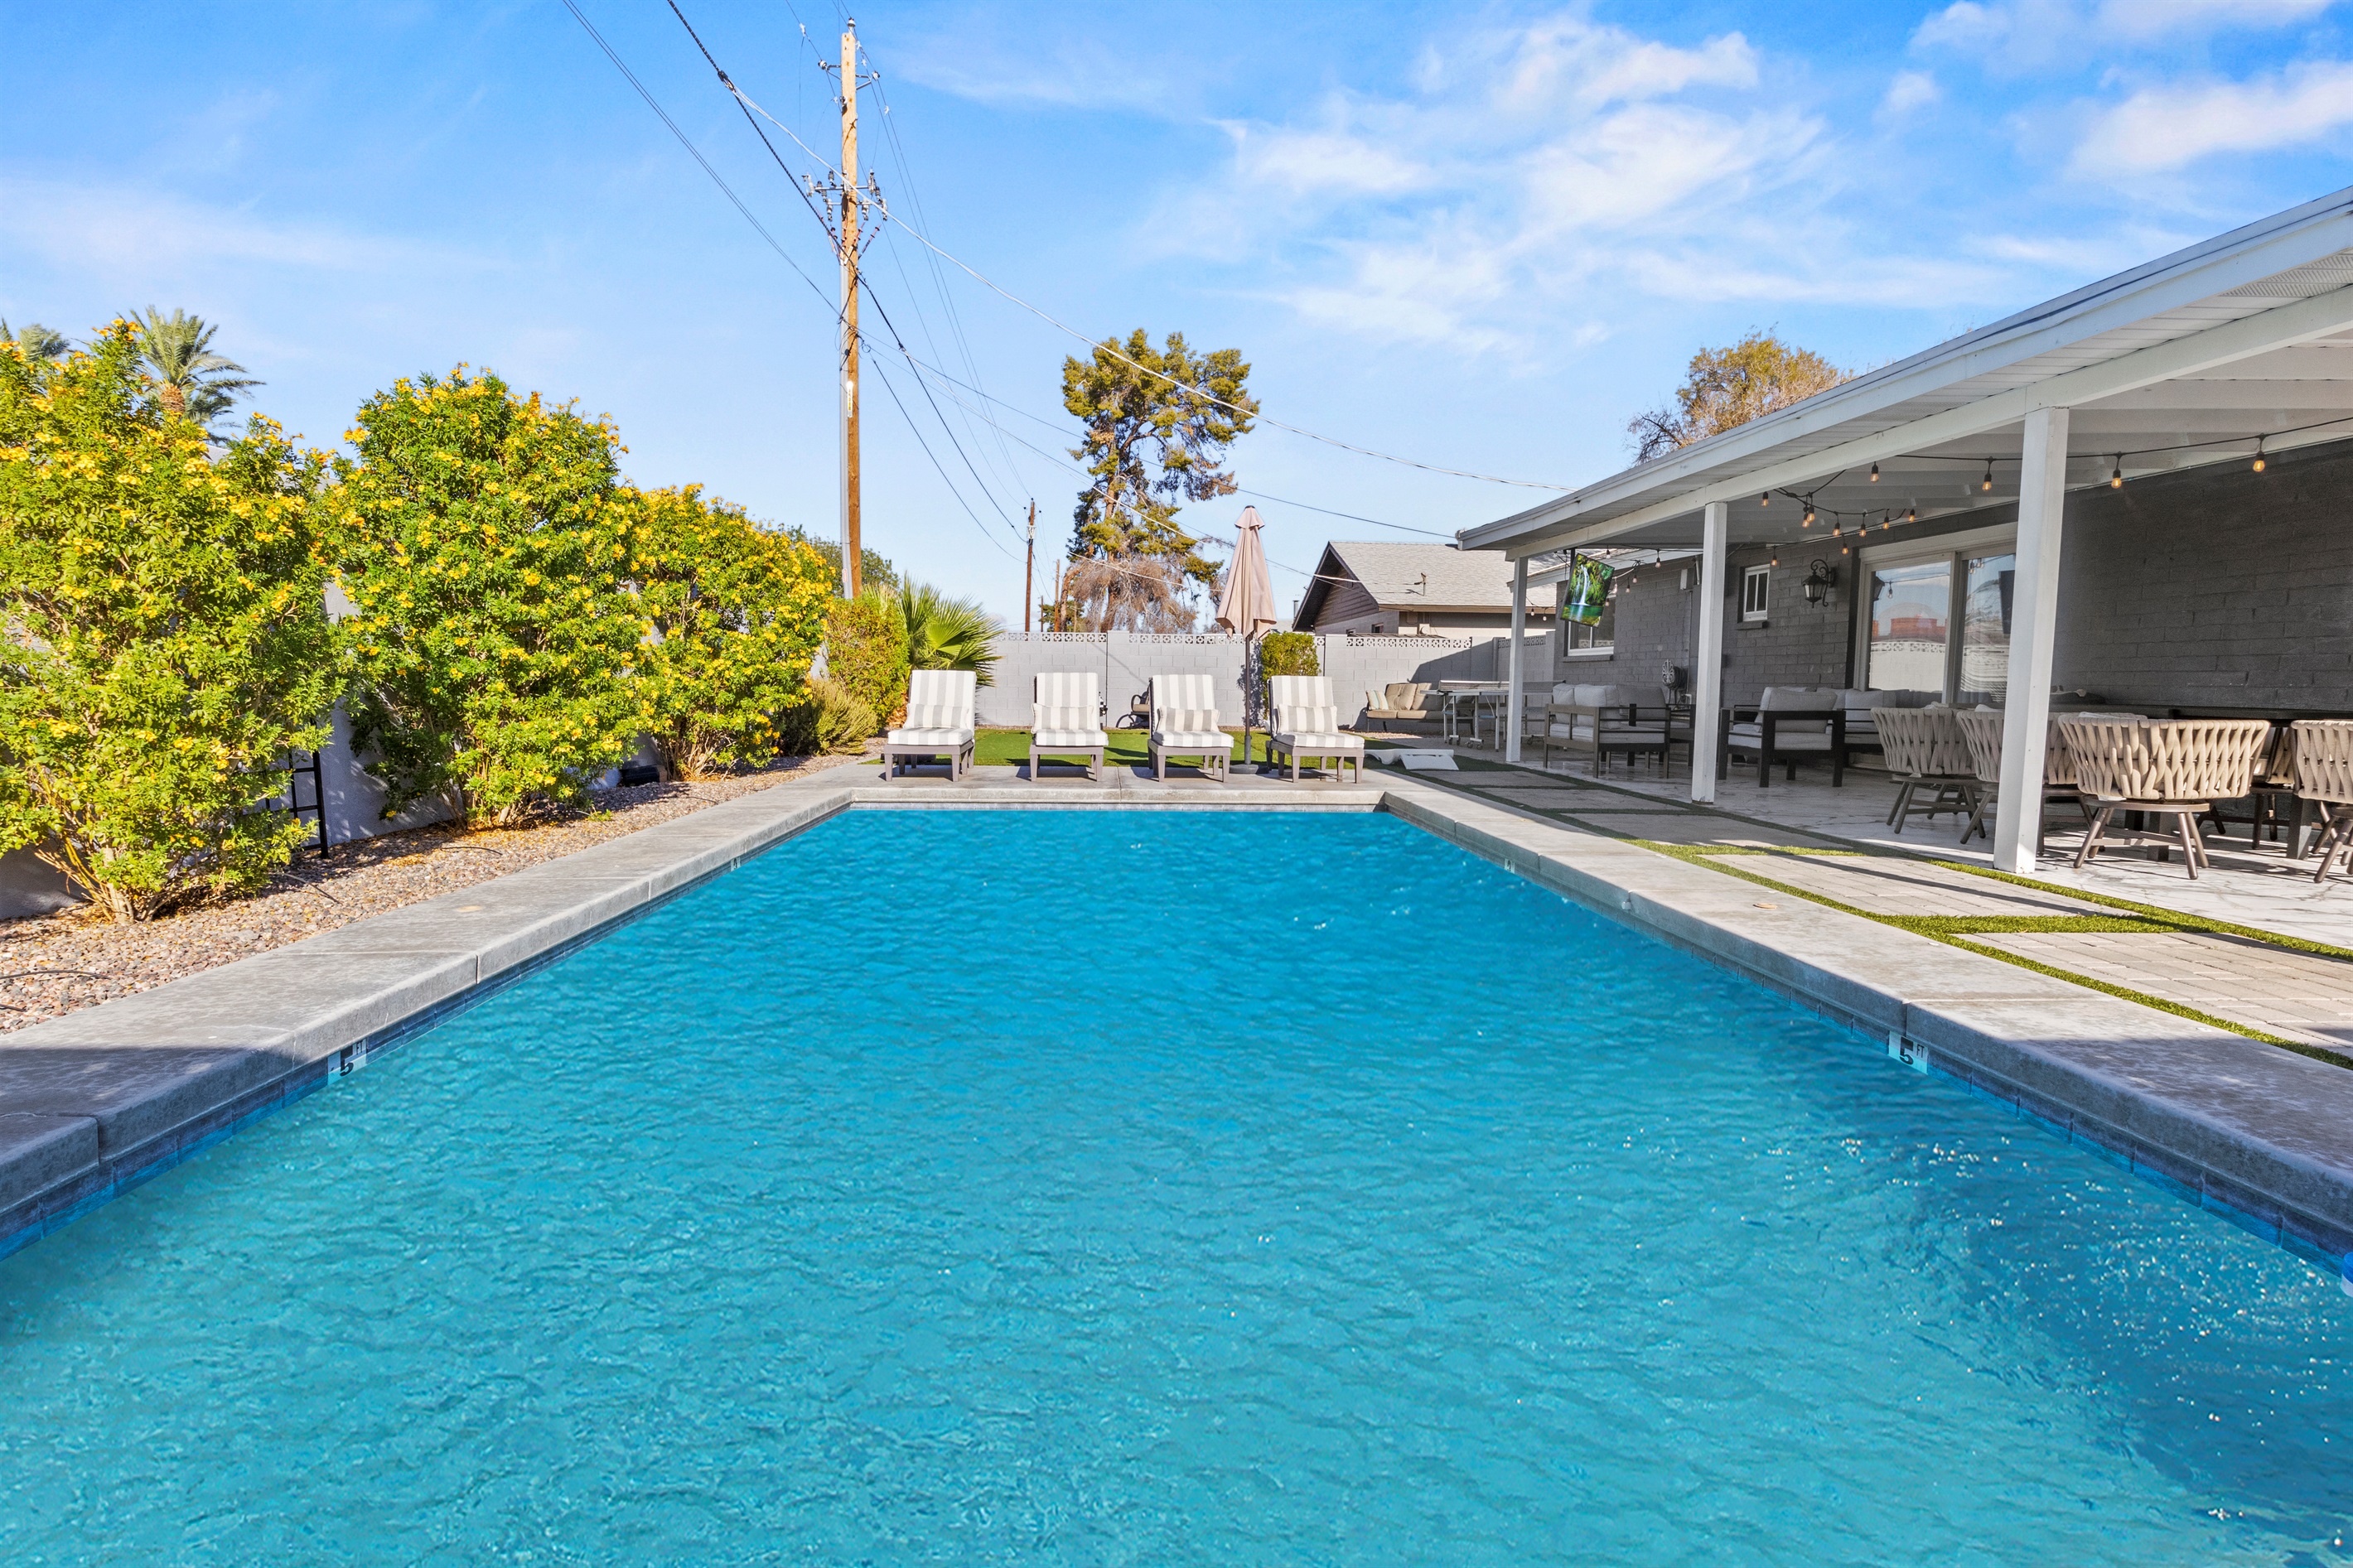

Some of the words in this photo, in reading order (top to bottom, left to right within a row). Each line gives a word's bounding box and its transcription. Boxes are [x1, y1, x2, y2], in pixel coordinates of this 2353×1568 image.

[340, 1045, 354, 1077] 5
[1900, 1036, 1914, 1065] 5
[1916, 1044, 1925, 1059] FT
